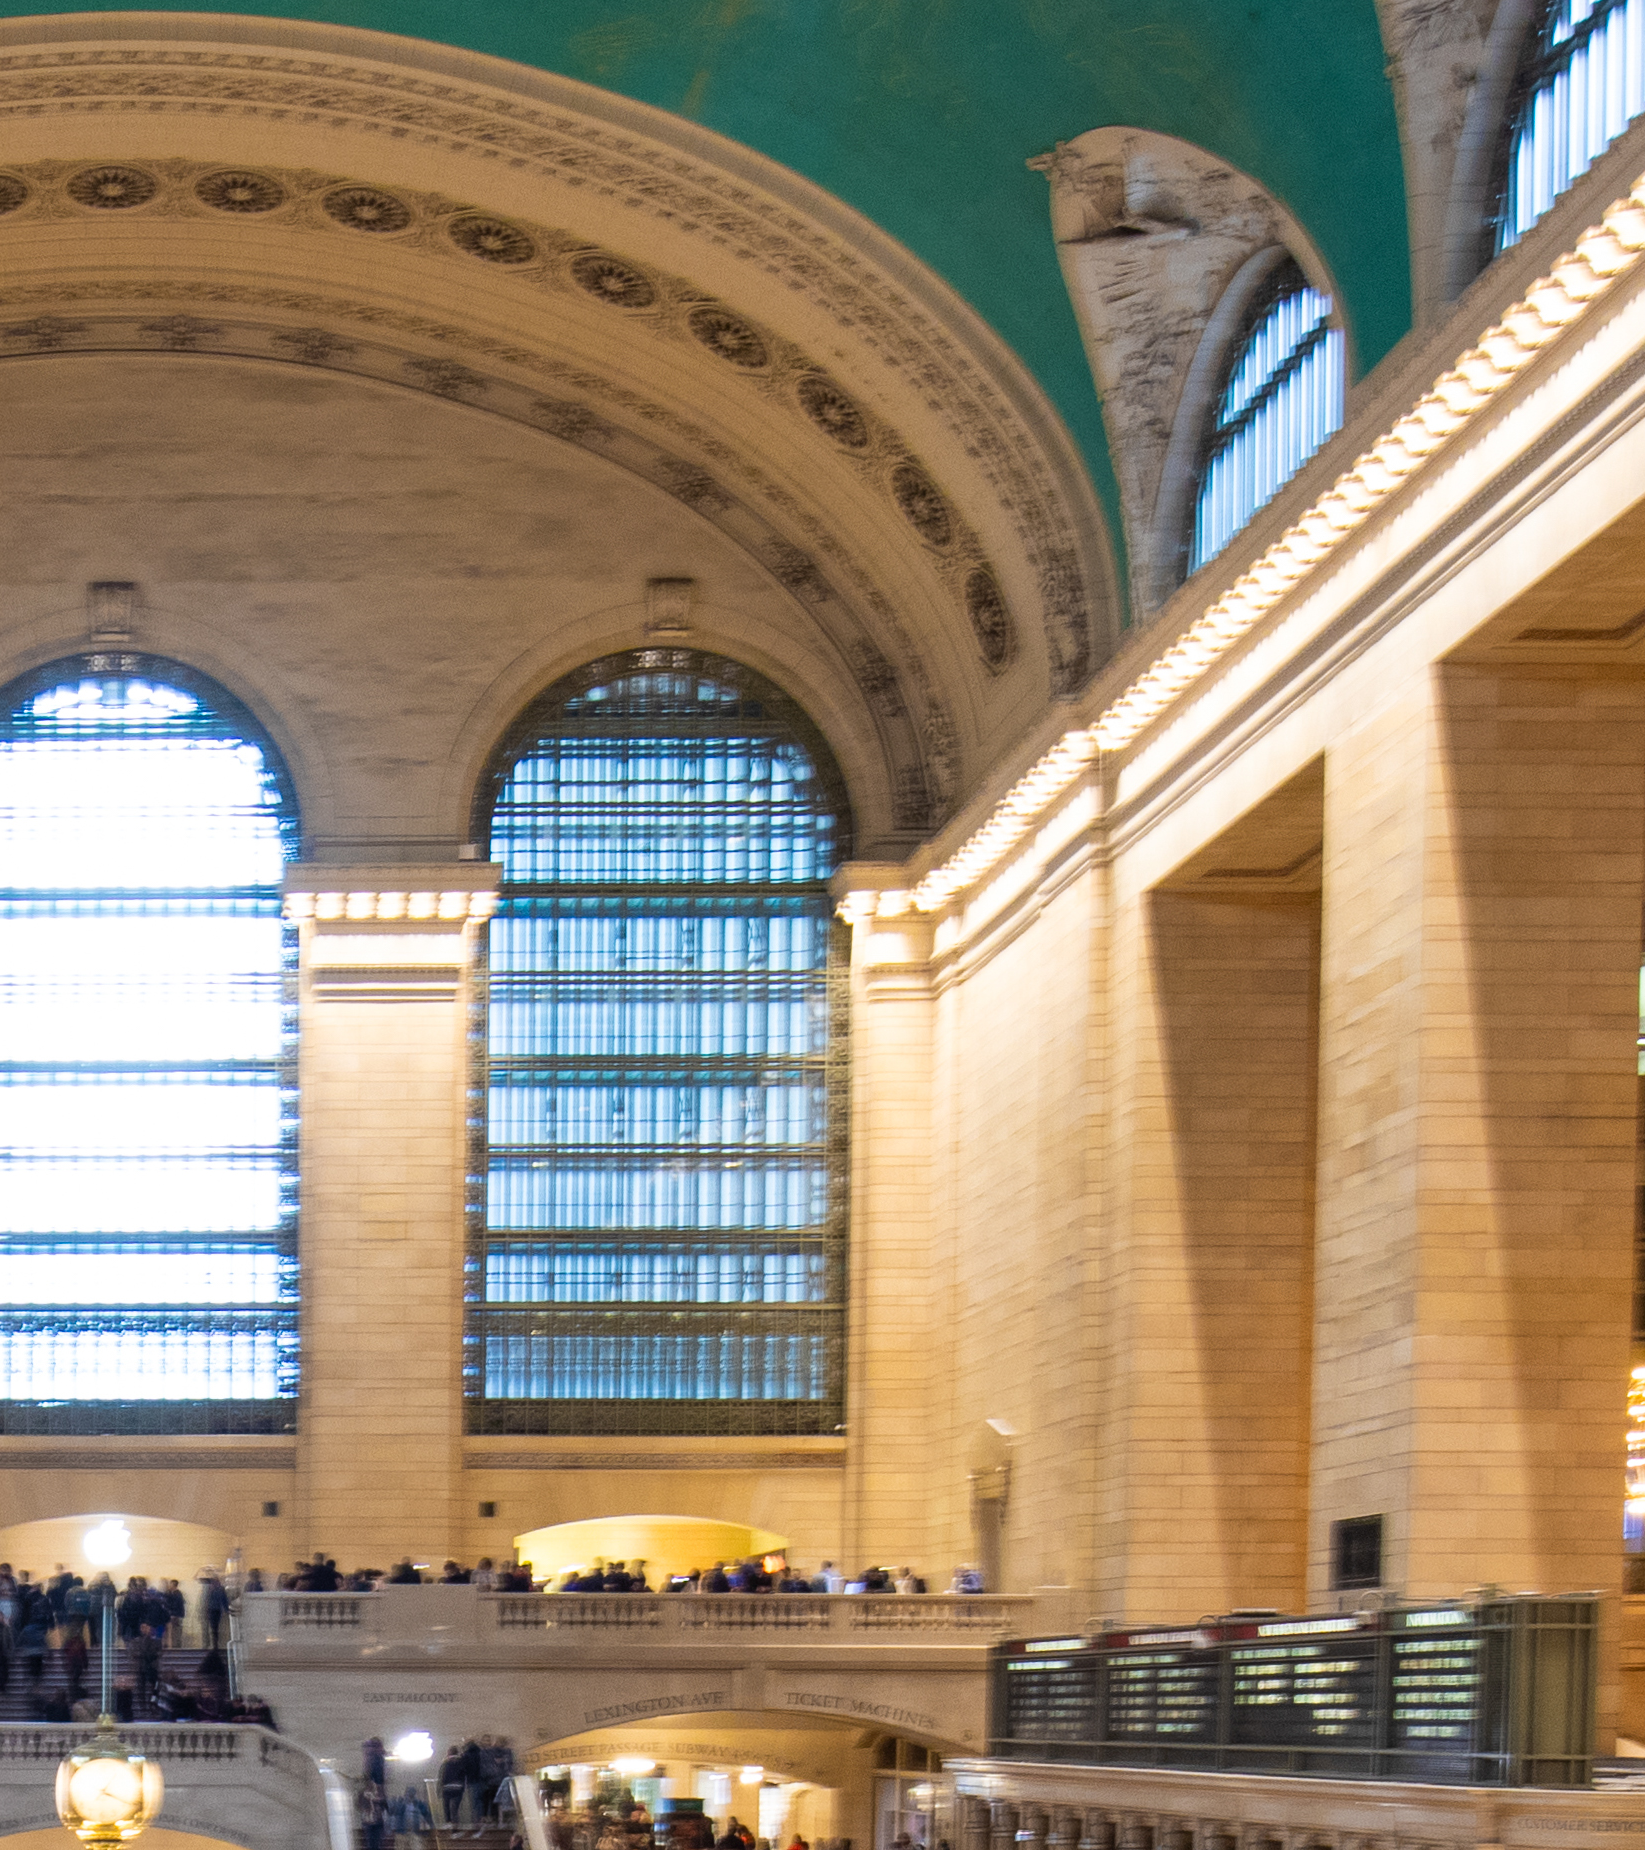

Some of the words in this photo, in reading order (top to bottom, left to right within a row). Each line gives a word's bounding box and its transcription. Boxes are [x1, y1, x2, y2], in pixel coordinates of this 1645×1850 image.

[584, 1694, 686, 1724] LEXINGTON
[783, 1692, 845, 1708] TICKET
[849, 1699, 940, 1729] MACHINES
